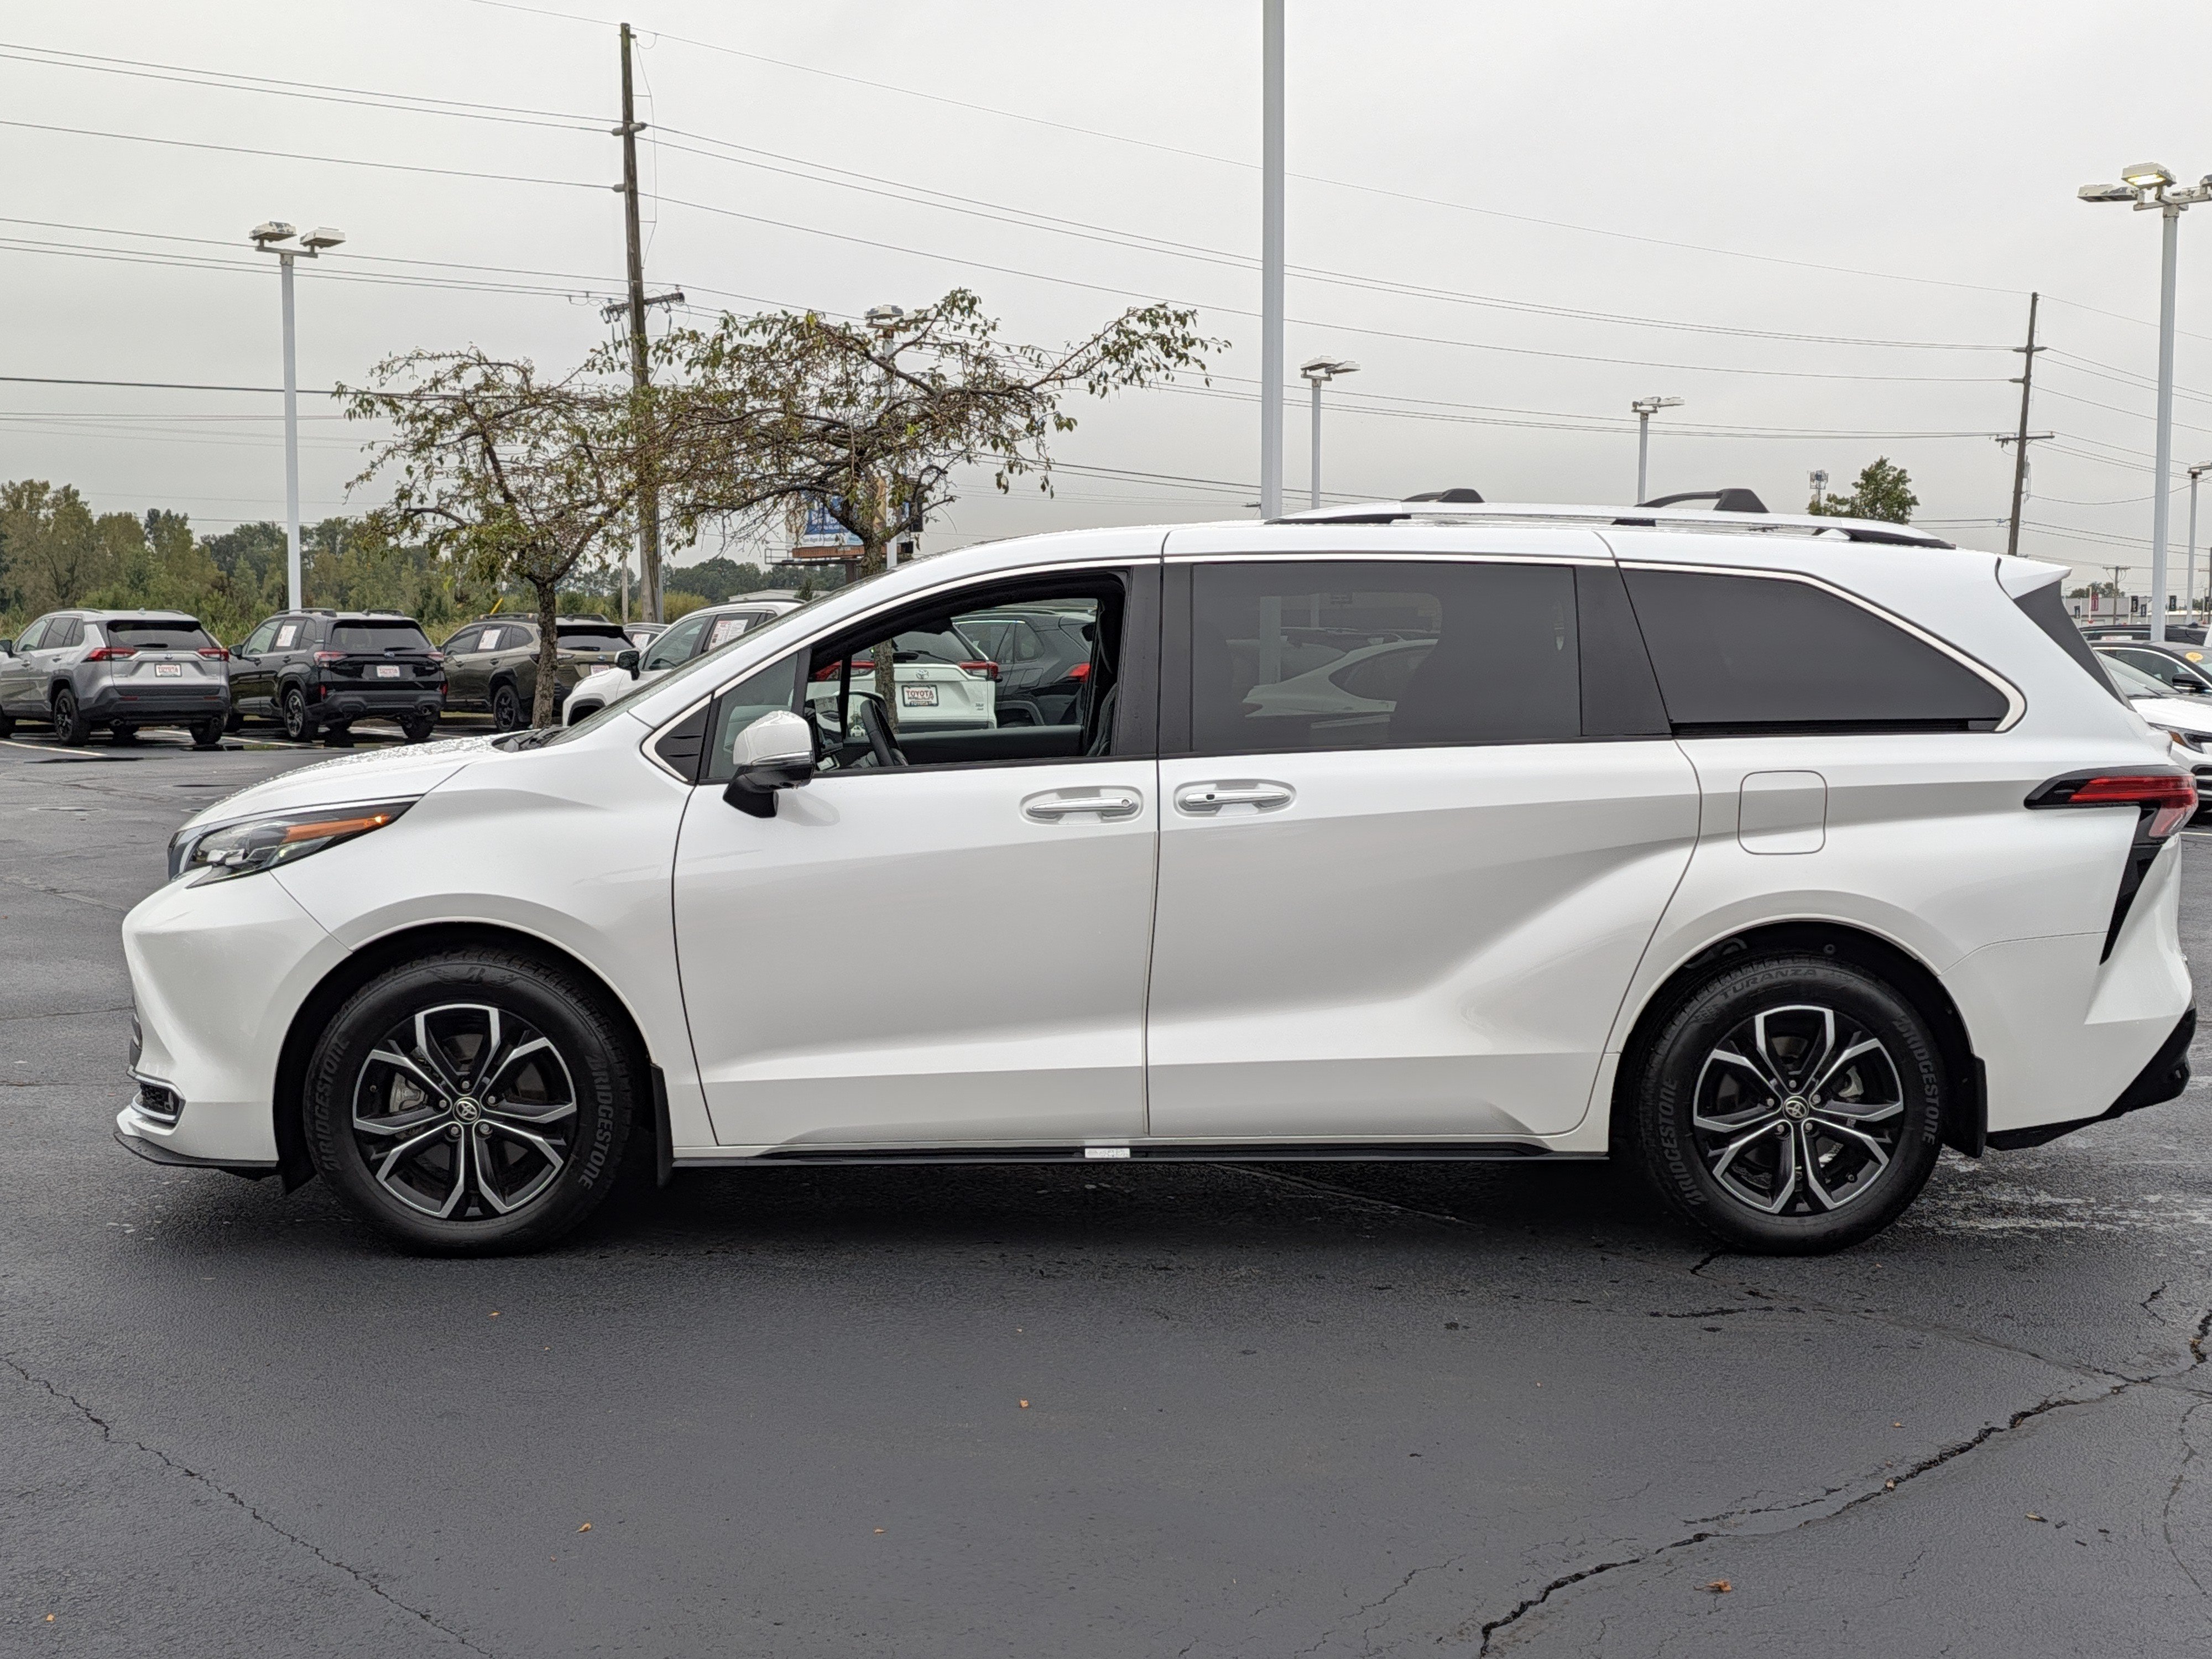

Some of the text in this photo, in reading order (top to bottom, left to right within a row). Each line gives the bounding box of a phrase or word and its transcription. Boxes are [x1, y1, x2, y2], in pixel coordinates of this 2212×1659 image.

[1720, 969, 1818, 999] TURANZA
[314, 1036, 350, 1171] BRIDGESTONE
[577, 1053, 615, 1191] BRIDGESTONE
[1658, 1077, 1709, 1206] BRIDGESTONE
[1891, 1015, 1939, 1145] BRIDGESTONE
